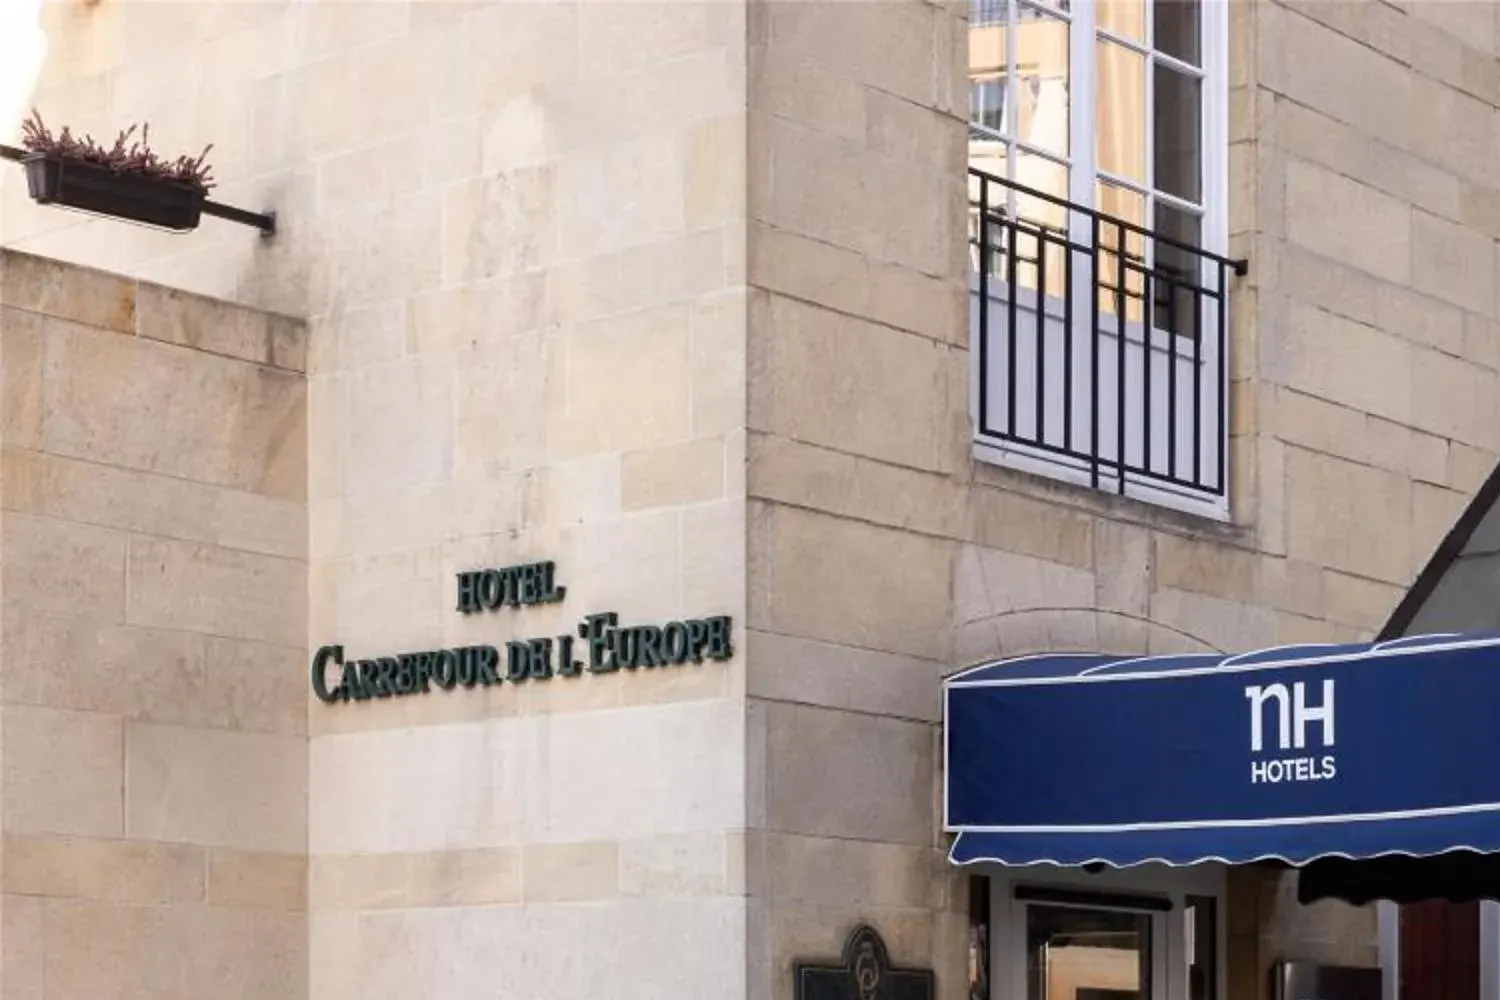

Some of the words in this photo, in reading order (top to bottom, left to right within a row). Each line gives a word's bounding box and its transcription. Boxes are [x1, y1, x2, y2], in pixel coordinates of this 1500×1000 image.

[455, 560, 566, 613] HOTEL
[311, 644, 500, 704] CARREFOUR
[506, 637, 553, 682] DE
[1251, 756, 1336, 783] HOTELS
